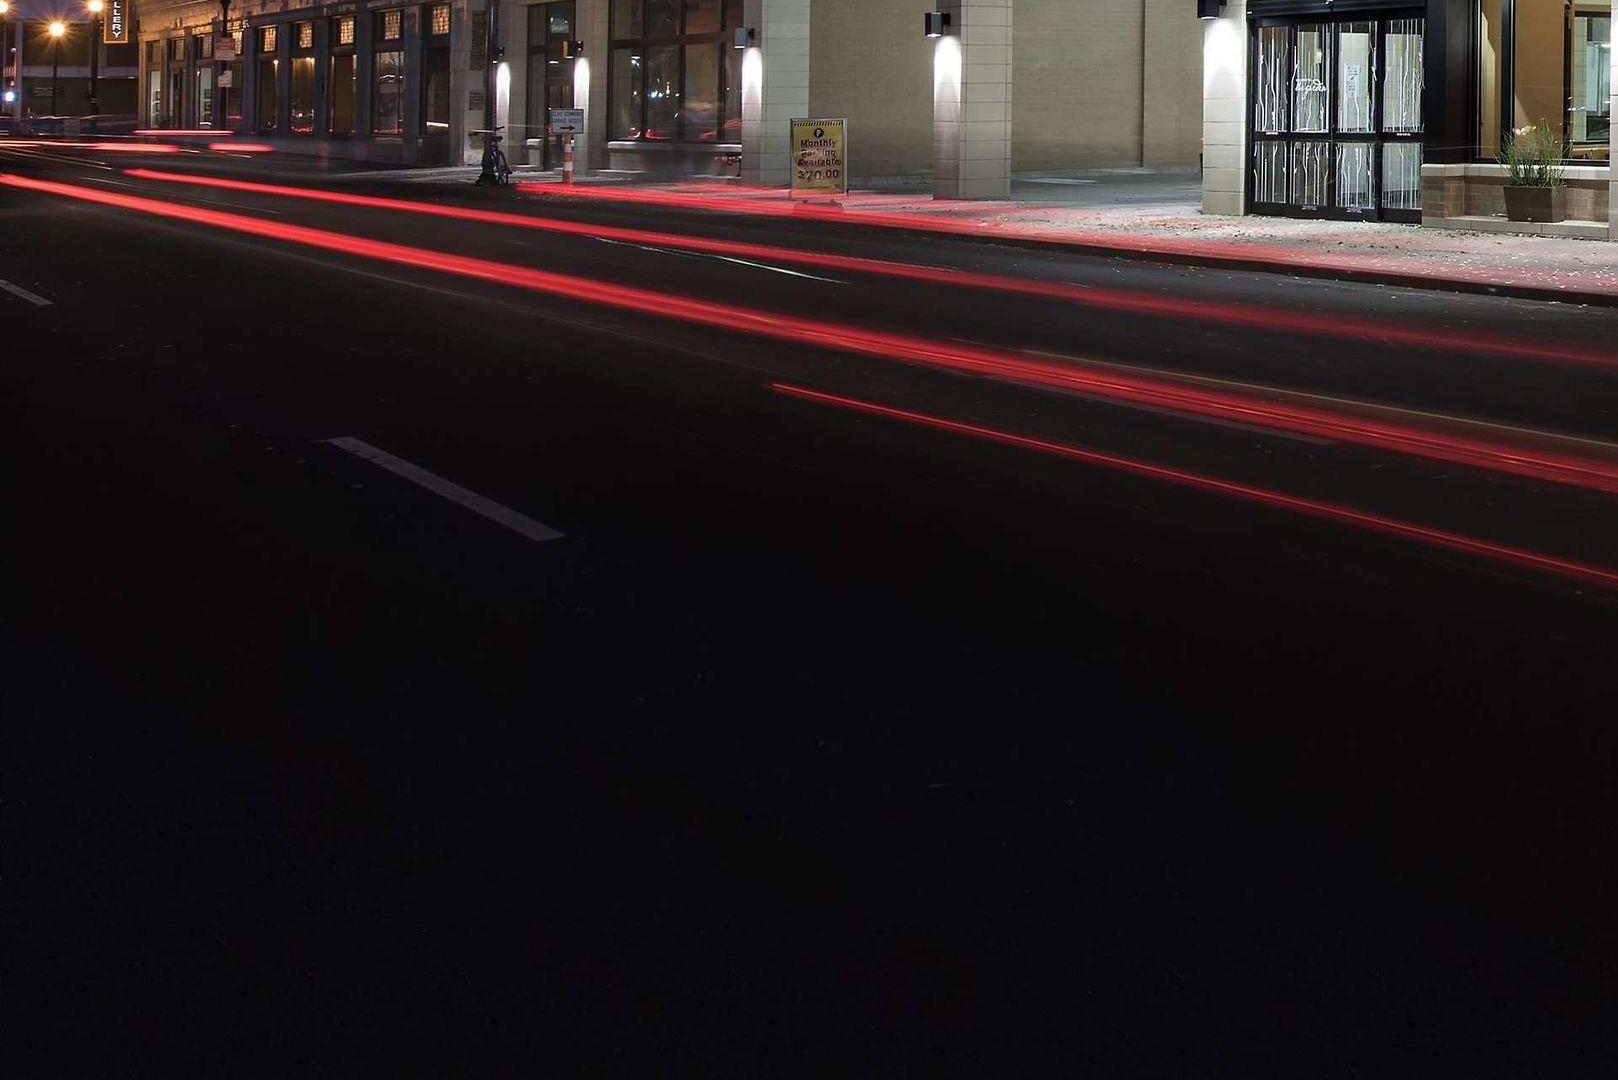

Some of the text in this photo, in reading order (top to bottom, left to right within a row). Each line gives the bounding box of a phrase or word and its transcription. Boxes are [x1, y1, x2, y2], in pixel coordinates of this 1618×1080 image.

[801, 139, 836, 148] Monthly
[801, 148, 836, 159] Paring
[797, 158, 841, 167] Available
